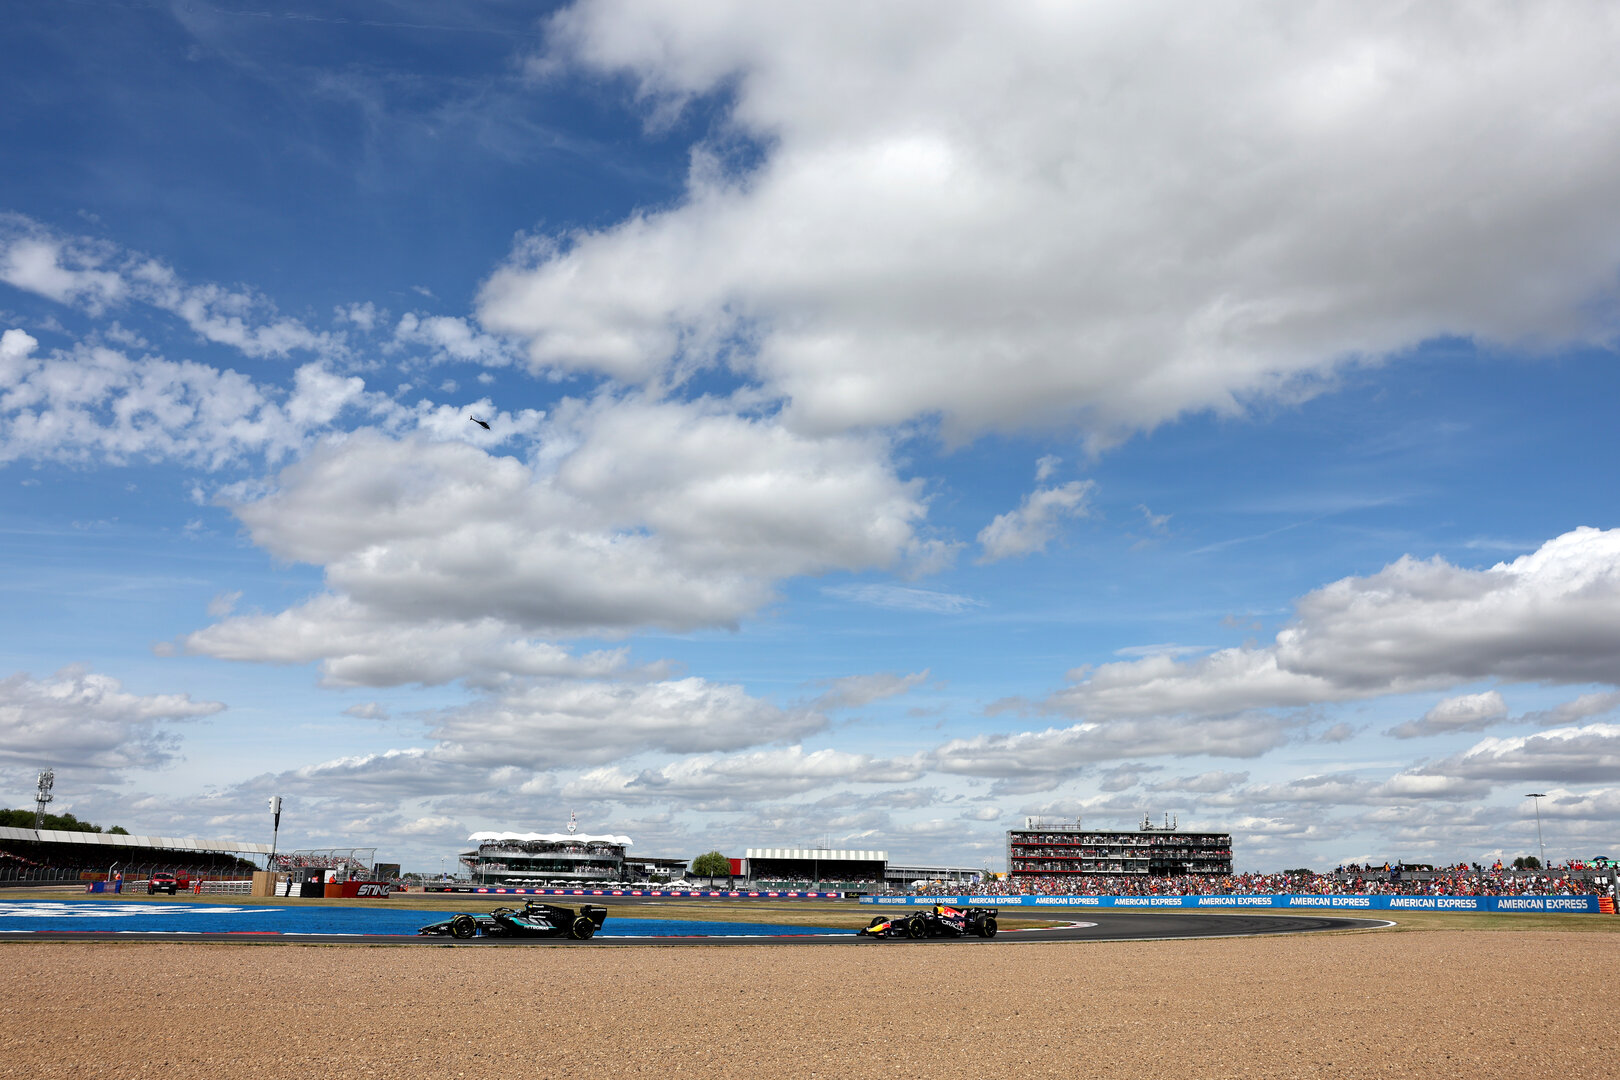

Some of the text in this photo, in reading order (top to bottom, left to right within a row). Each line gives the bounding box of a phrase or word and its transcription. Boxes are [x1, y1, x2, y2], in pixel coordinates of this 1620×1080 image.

[357, 884, 390, 896] STING
[1035, 897, 1099, 905] AMERICAN EXPRESS
[1150, 898, 1183, 906] EXPRESS
[1198, 897, 1273, 905] AMERICAN EXPRESS
[1289, 897, 1370, 907] AMERICAN EXPRESS
[1389, 898, 1477, 908] AMERICAN EXPRESS
[1497, 898, 1588, 909] AMERICAN EXPRESS
